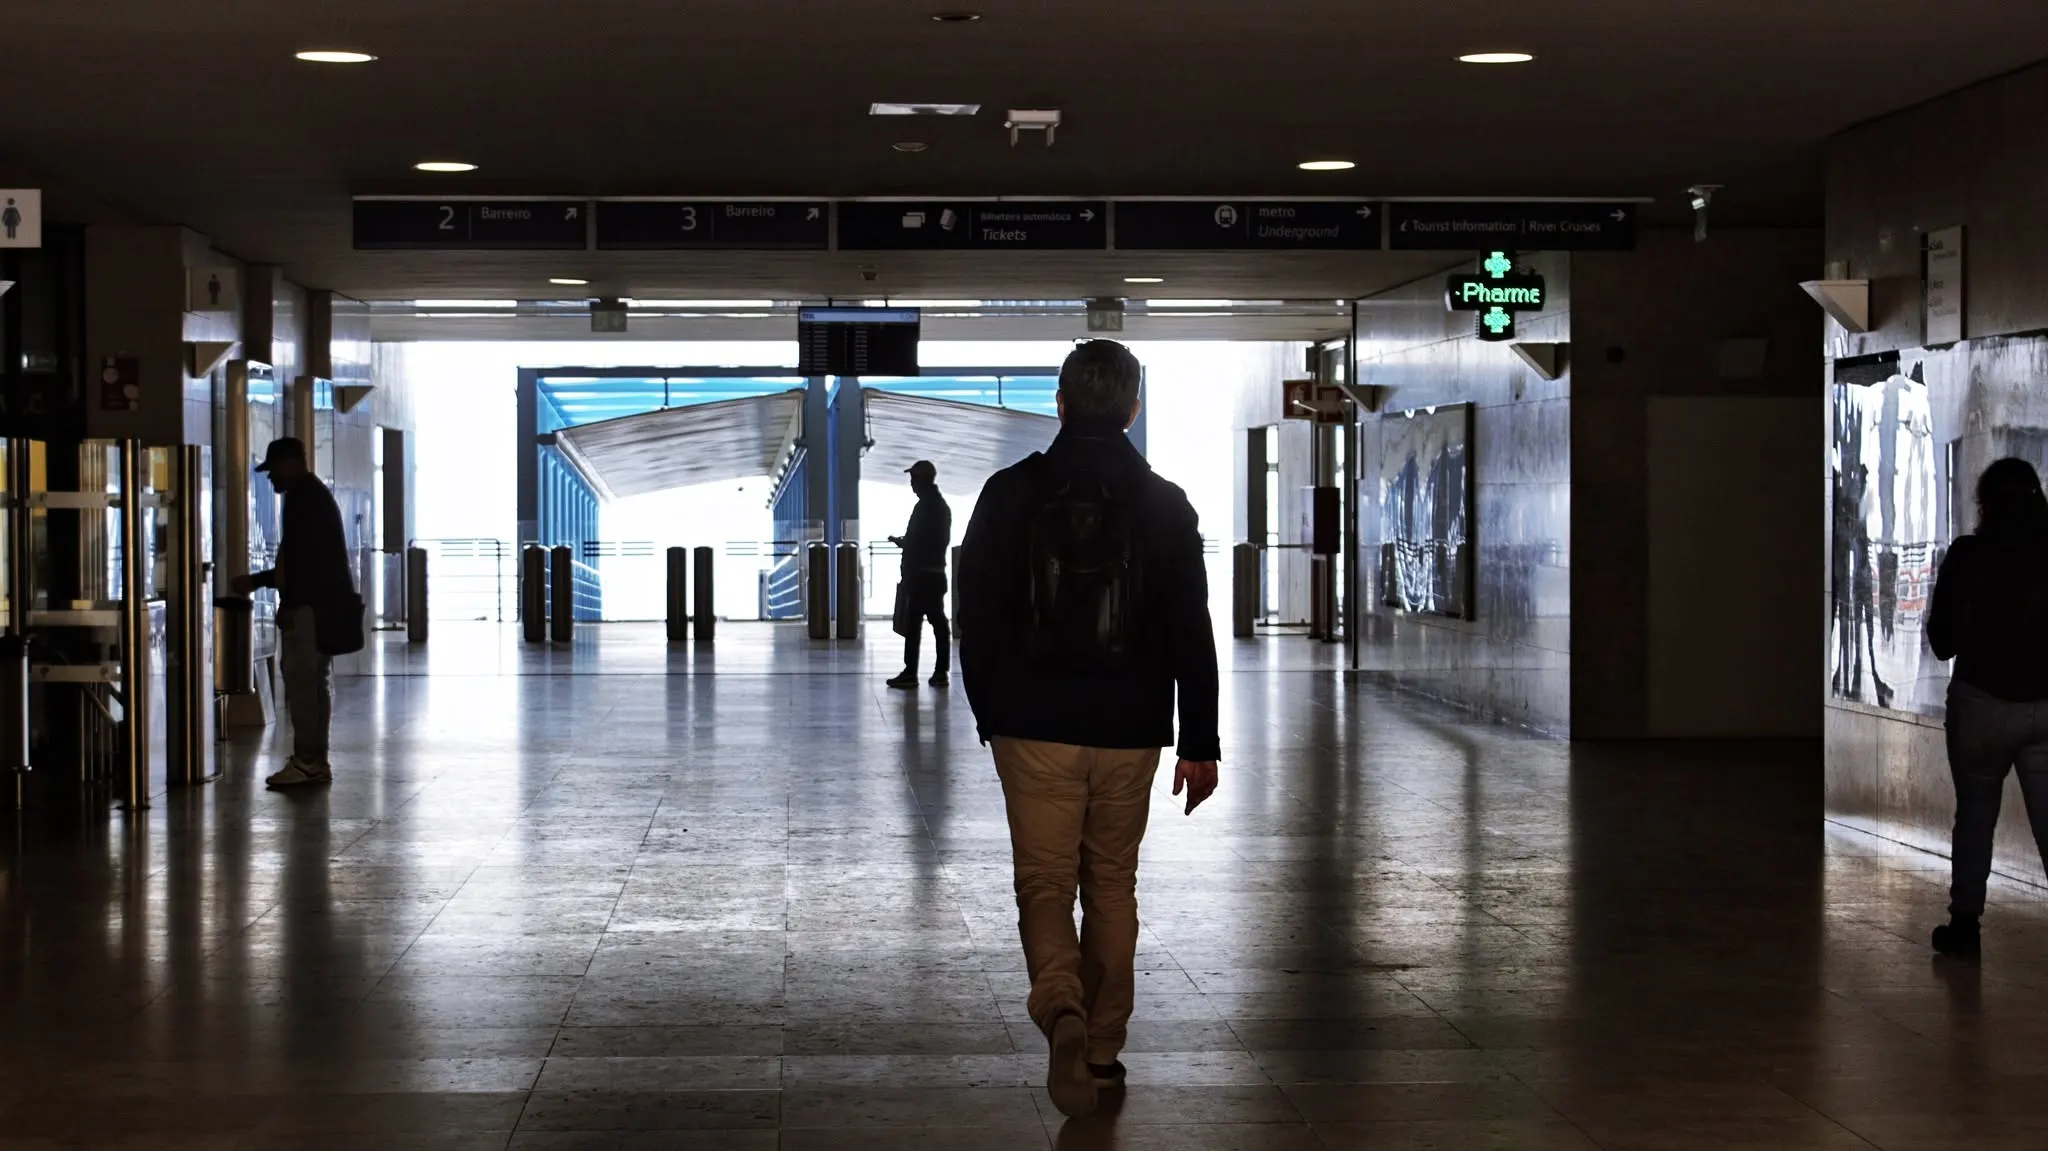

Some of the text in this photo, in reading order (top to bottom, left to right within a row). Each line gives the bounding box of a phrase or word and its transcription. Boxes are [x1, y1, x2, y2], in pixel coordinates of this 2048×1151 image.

[481, 206, 531, 219] Barreiro
[726, 204, 775, 217] Barreiro
[1258, 207, 1296, 217] metro
[439, 205, 454, 230] 2
[680, 206, 697, 231] 3
[1258, 224, 1339, 240] Underground
[1412, 219, 1450, 232] Tourist
[1452, 219, 1516, 232] Information
[1529, 219, 1557, 232] River
[1559, 219, 1601, 232] Cruises
[982, 228, 1027, 241] Tickets
